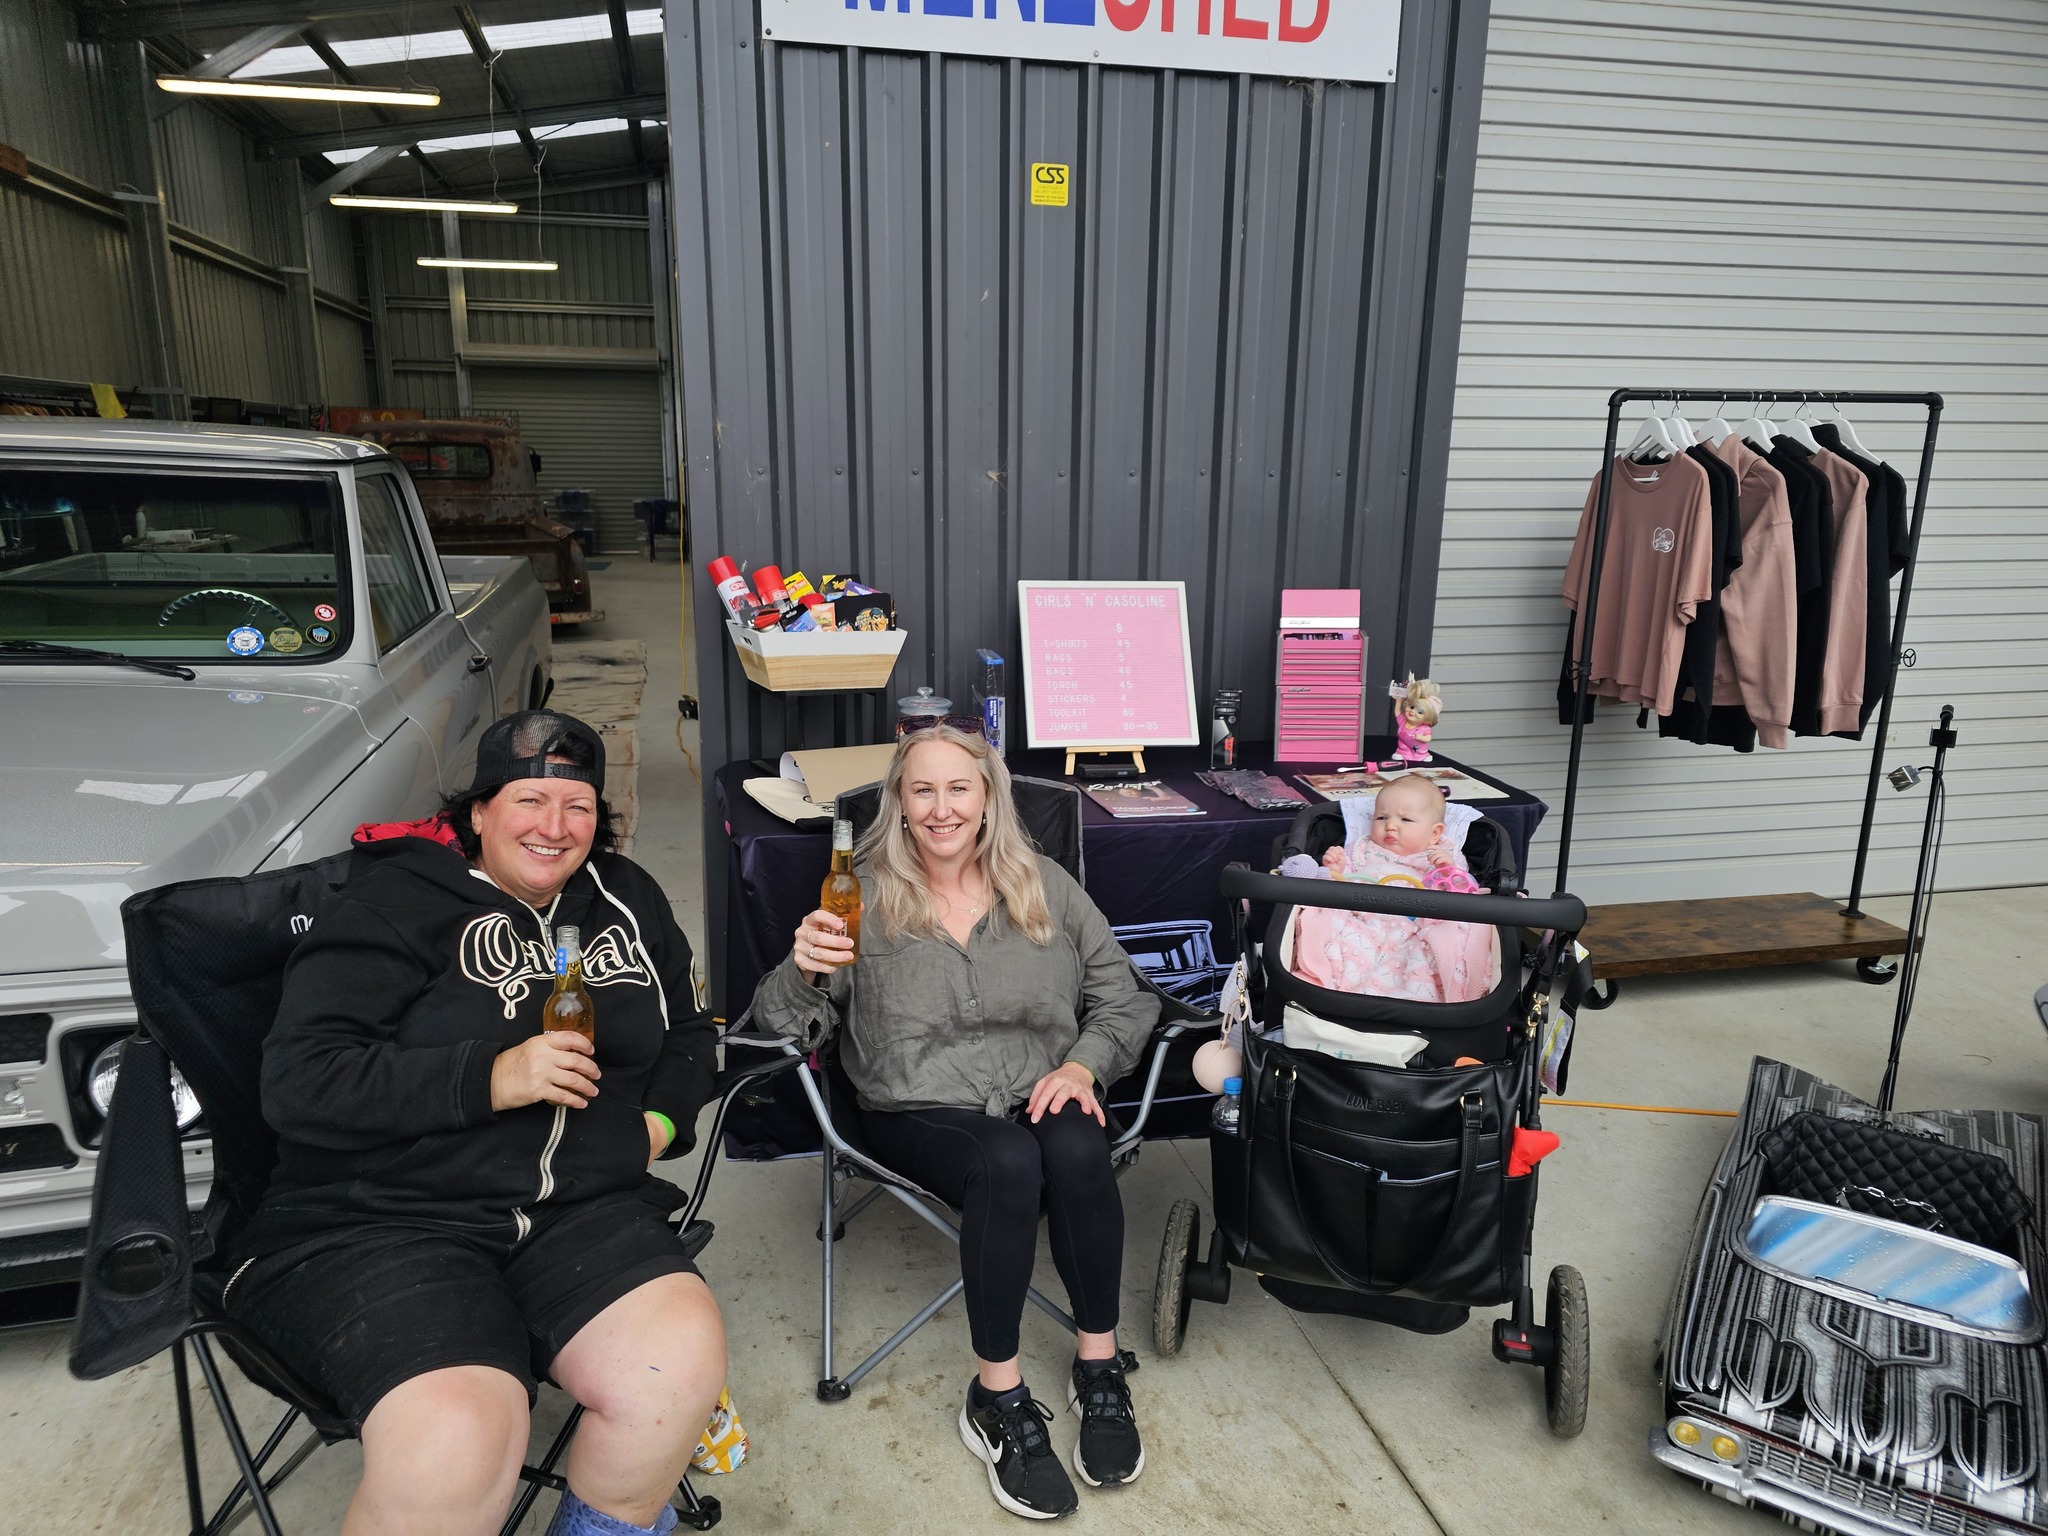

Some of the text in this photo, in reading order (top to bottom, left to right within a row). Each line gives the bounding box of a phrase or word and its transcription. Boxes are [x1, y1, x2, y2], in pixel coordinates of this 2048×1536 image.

[1036, 167, 1065, 184] CSS
[1035, 595, 1071, 607] GIRLS
[1105, 595, 1166, 607] GASOLINE
[1116, 622, 1124, 634] $
[1043, 640, 1131, 648] T-SHIRTS 45
[1119, 653, 1125, 662] 5
[1119, 667, 1132, 675] 40
[1047, 681, 1133, 689] TORCH 45
[1048, 695, 1127, 704] STICKERS 4
[1048, 709, 1087, 718] TOOLKIT
[1048, 722, 1088, 732] JUMPER
